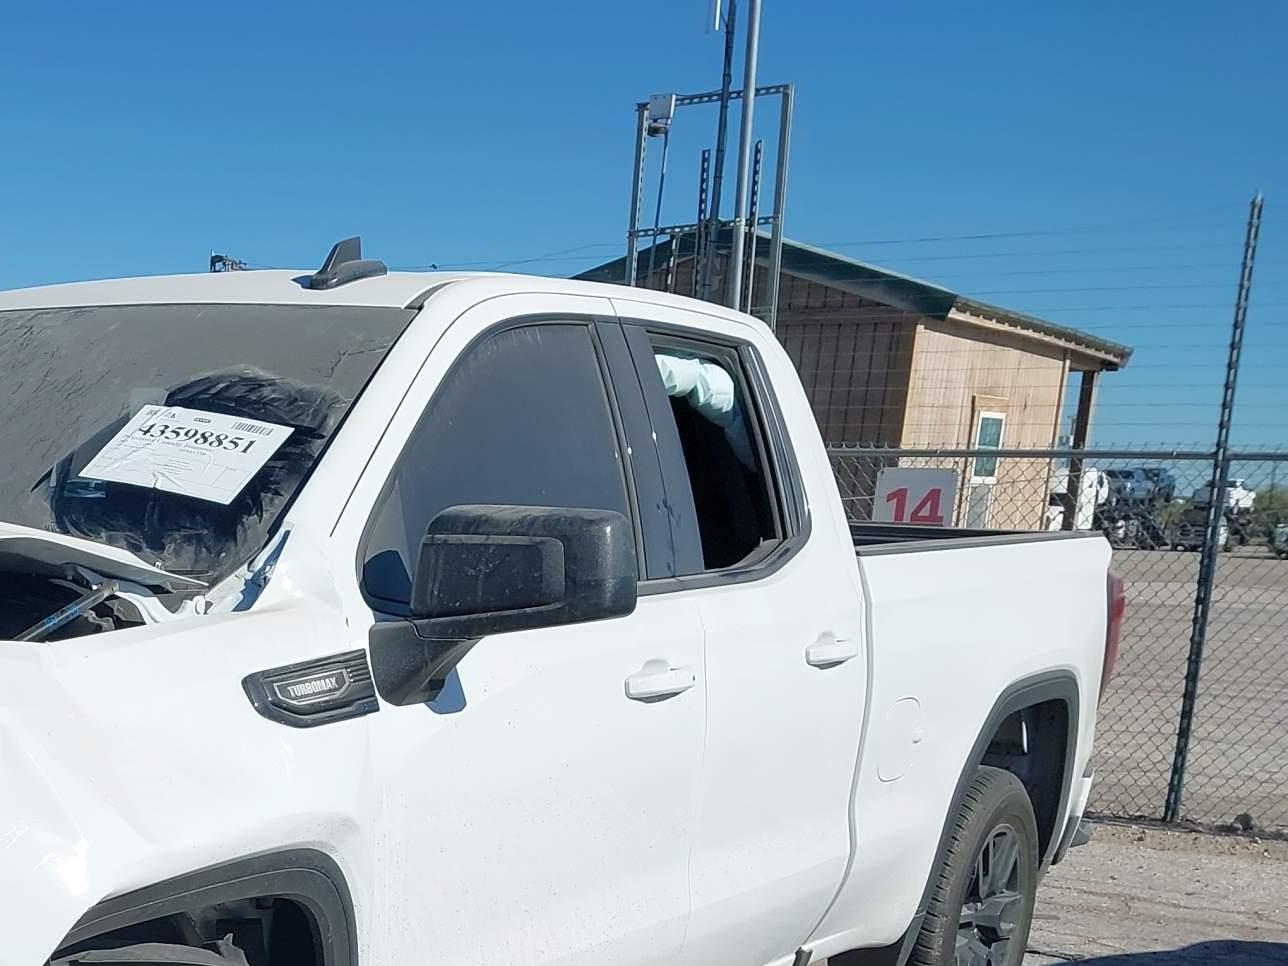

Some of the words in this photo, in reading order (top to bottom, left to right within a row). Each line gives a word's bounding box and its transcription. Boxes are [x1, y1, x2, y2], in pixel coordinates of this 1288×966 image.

[139, 422, 257, 454] 43598851
[887, 487, 944, 526] 14
[287, 676, 339, 698] TURBOMAX
